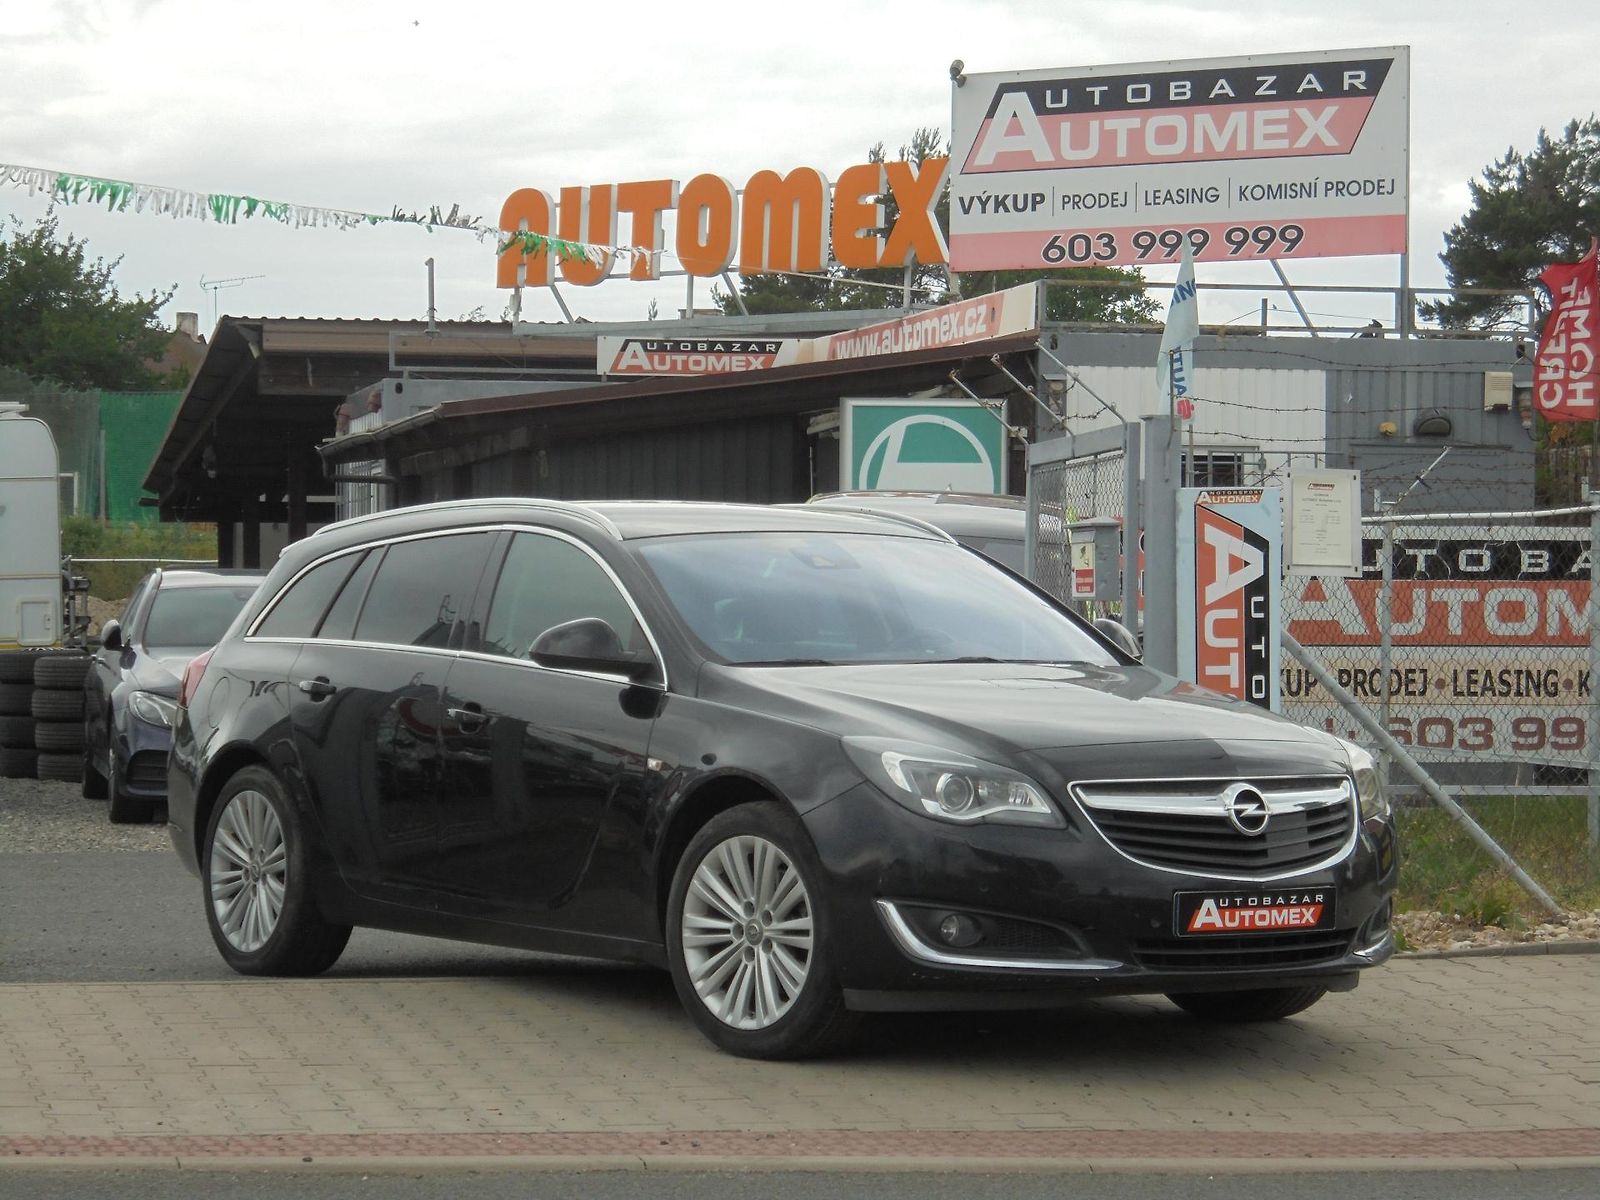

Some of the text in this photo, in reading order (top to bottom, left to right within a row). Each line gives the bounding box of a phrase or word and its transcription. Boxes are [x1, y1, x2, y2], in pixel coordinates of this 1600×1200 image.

[973, 91, 1341, 166] AUTOMEX
[958, 176, 1396, 215] VÝKUP PRODEJ LEASING KOMISNÍ PRODEJ
[497, 158, 949, 289] AUTOMEX
[1041, 223, 1306, 264] 603 999 999
[836, 303, 988, 360] www.automex.cz
[617, 341, 766, 373] AUTOMEX
[1196, 491, 1259, 504] AUTOMEX
[1338, 668, 1428, 697] PRODEJ
[1452, 668, 1559, 698] LEASING
[1193, 899, 1316, 928] AUTOMEX
